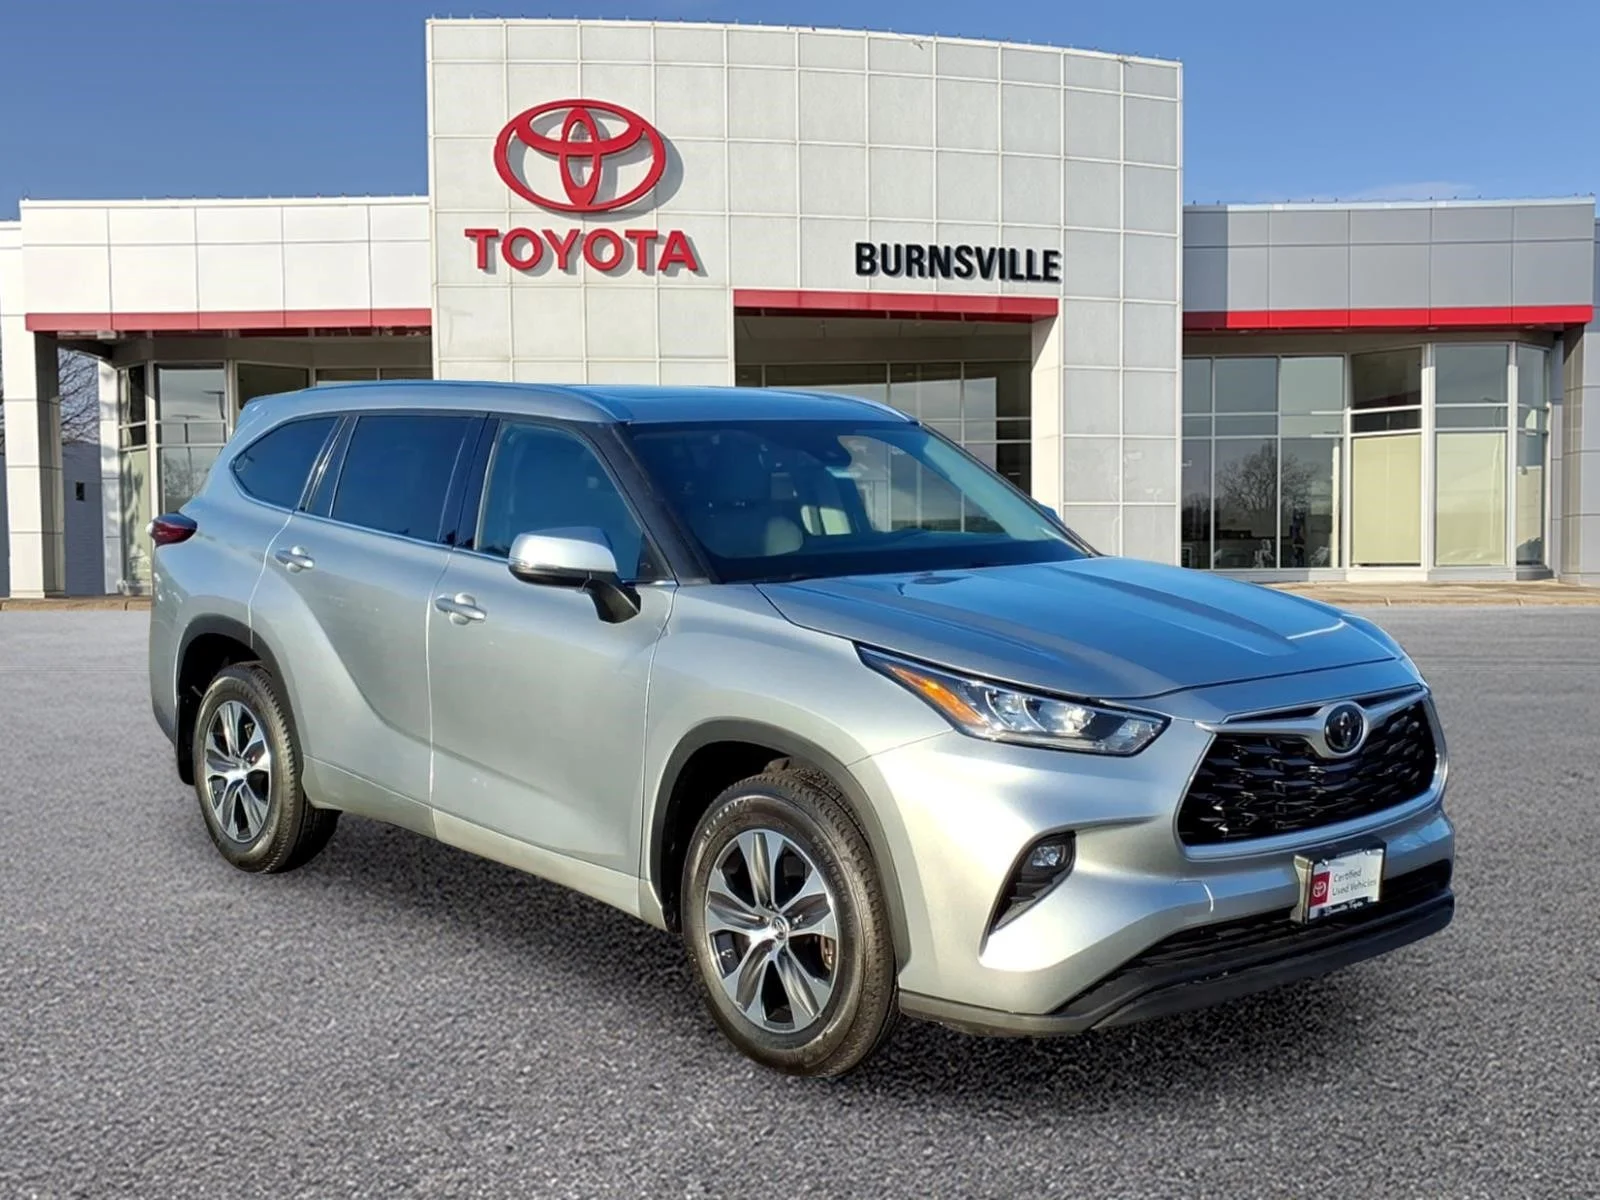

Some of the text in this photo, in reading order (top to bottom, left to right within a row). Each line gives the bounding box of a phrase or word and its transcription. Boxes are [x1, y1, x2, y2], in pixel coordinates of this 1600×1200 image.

[464, 227, 699, 271] TOYOTA
[855, 242, 1061, 282] BURNSVILLE
[1334, 868, 1362, 882] Certified
